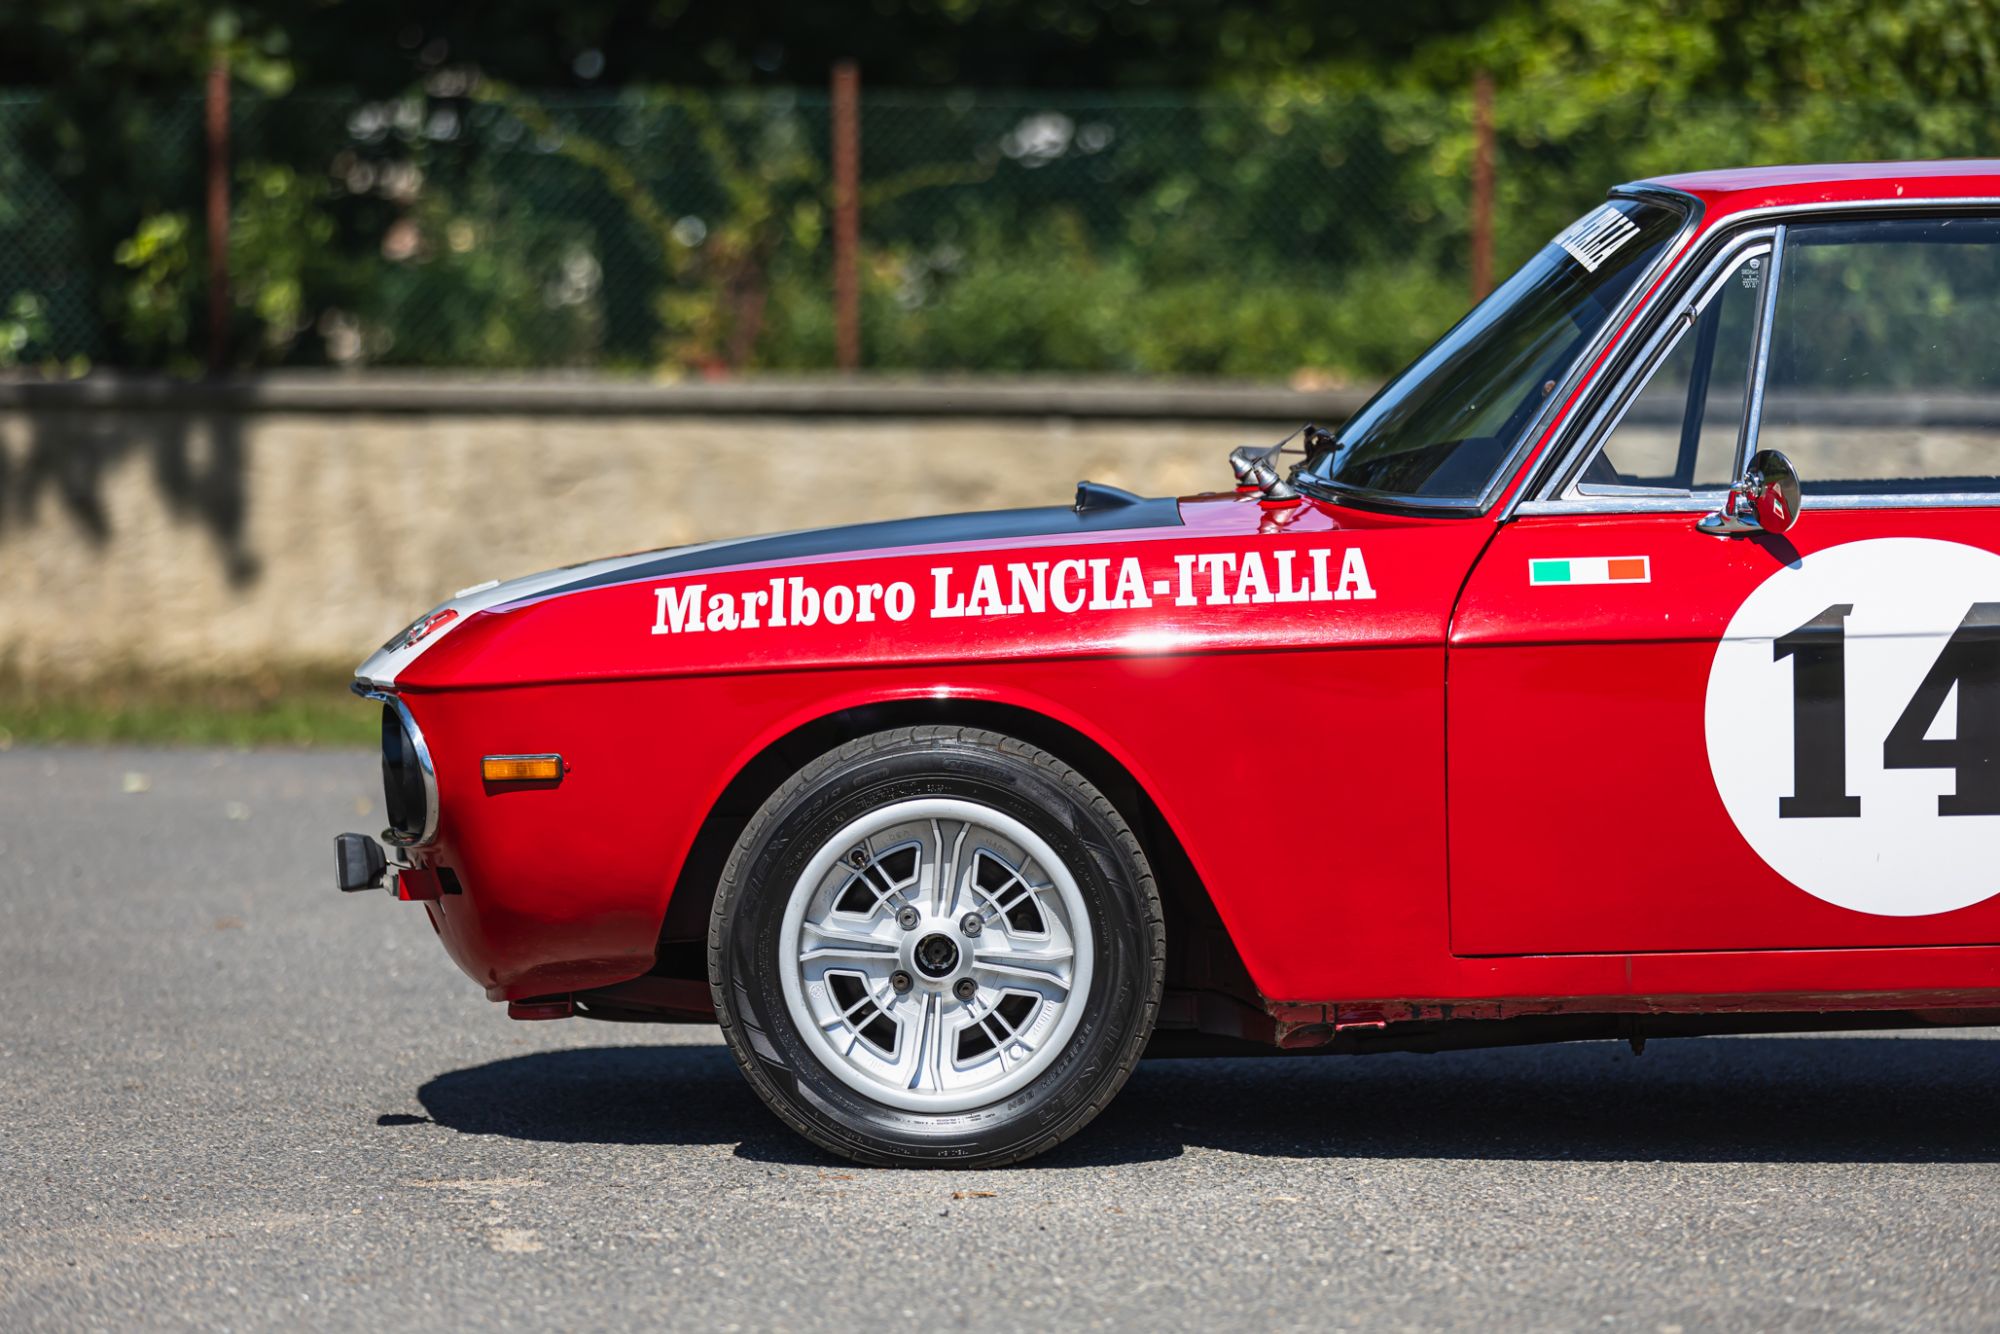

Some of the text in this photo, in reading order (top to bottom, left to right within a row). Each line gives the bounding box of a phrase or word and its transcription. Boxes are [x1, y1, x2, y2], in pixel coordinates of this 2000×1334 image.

[651, 547, 1377, 635] Marlboro LANCIA-ITALIA
[1773, 601, 2000, 818] 14
